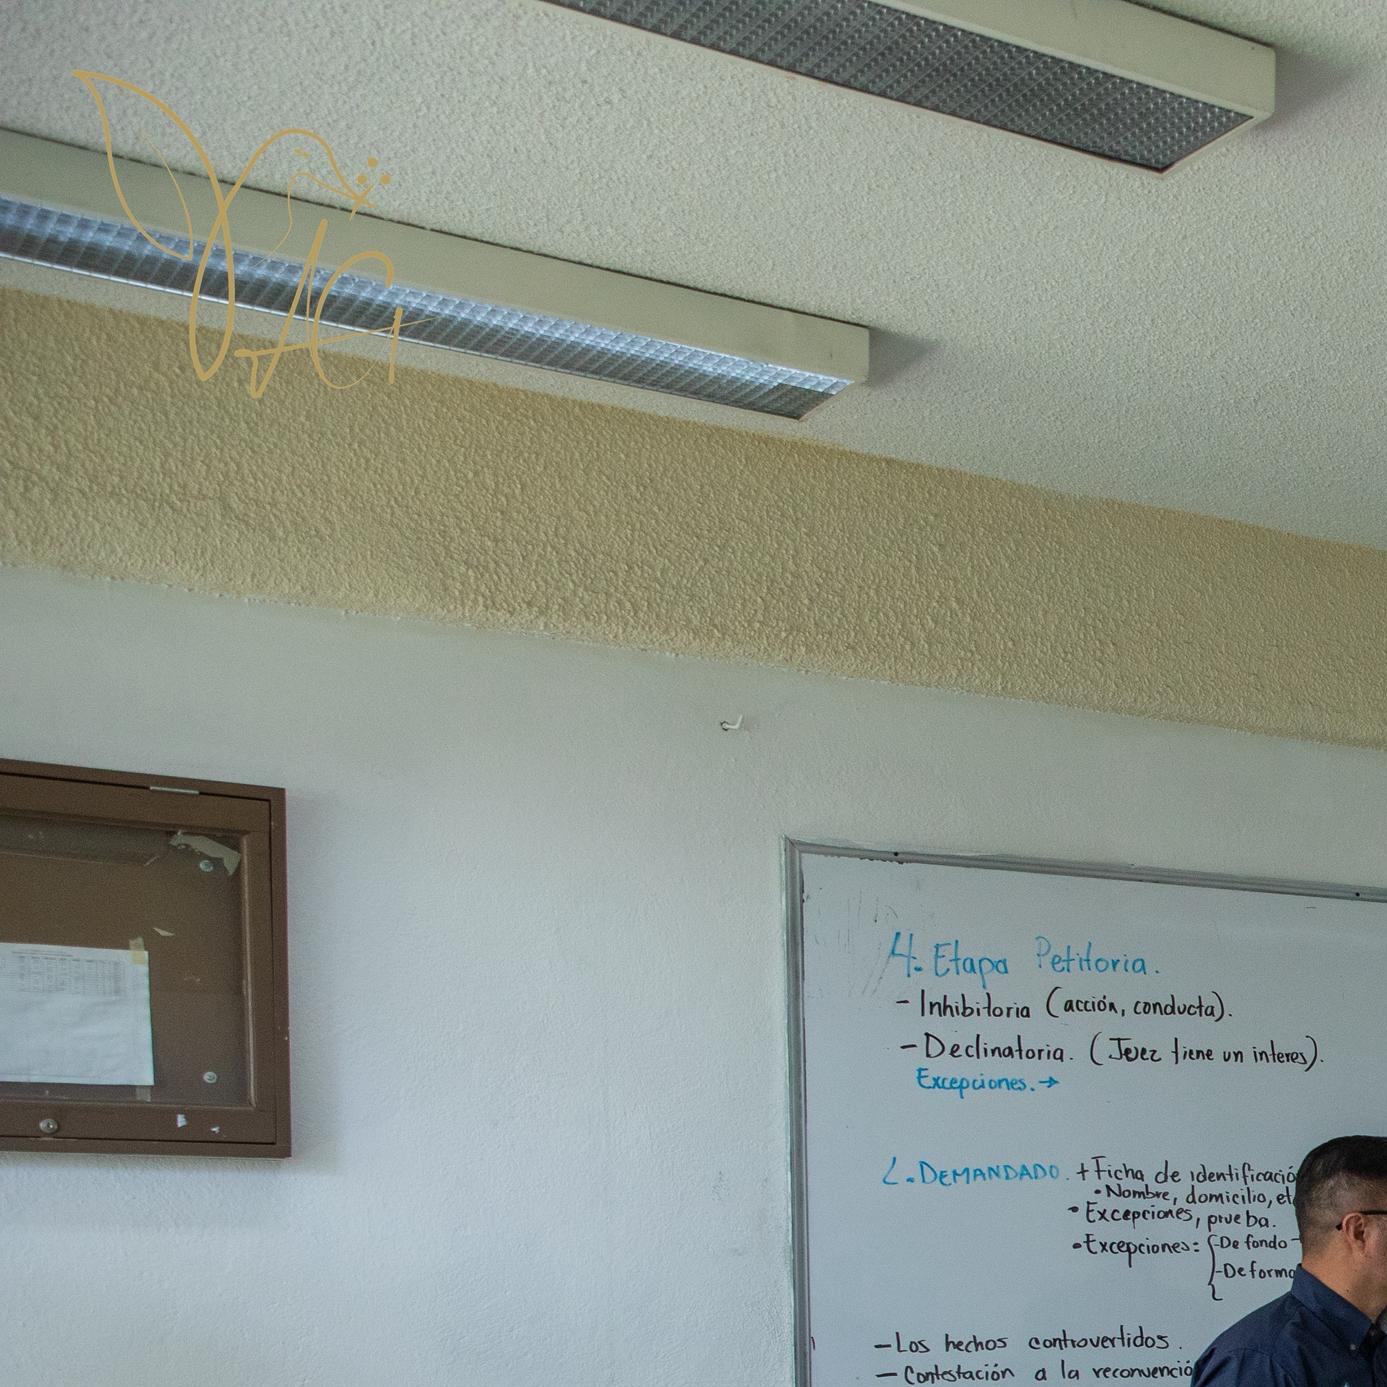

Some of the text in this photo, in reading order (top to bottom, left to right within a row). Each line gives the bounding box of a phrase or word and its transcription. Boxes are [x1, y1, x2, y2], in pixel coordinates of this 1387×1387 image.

[890, 931, 924, 978] 4.
[933, 939, 1009, 990] Etapa
[1133, 991, 1232, 1022] conducta).
[1171, 1037, 1214, 1064] tiene
[1223, 1048, 1244, 1063] un
[1154, 1160, 1182, 1184] de
[1190, 1162, 1297, 1186] identificació
[1105, 1184, 1177, 1205] Nombre,
[1245, 1234, 1287, 1250] fondo
[945, 1334, 1009, 1353] hechos
[904, 1360, 1193, 1384] Contestación a la reconvenció
